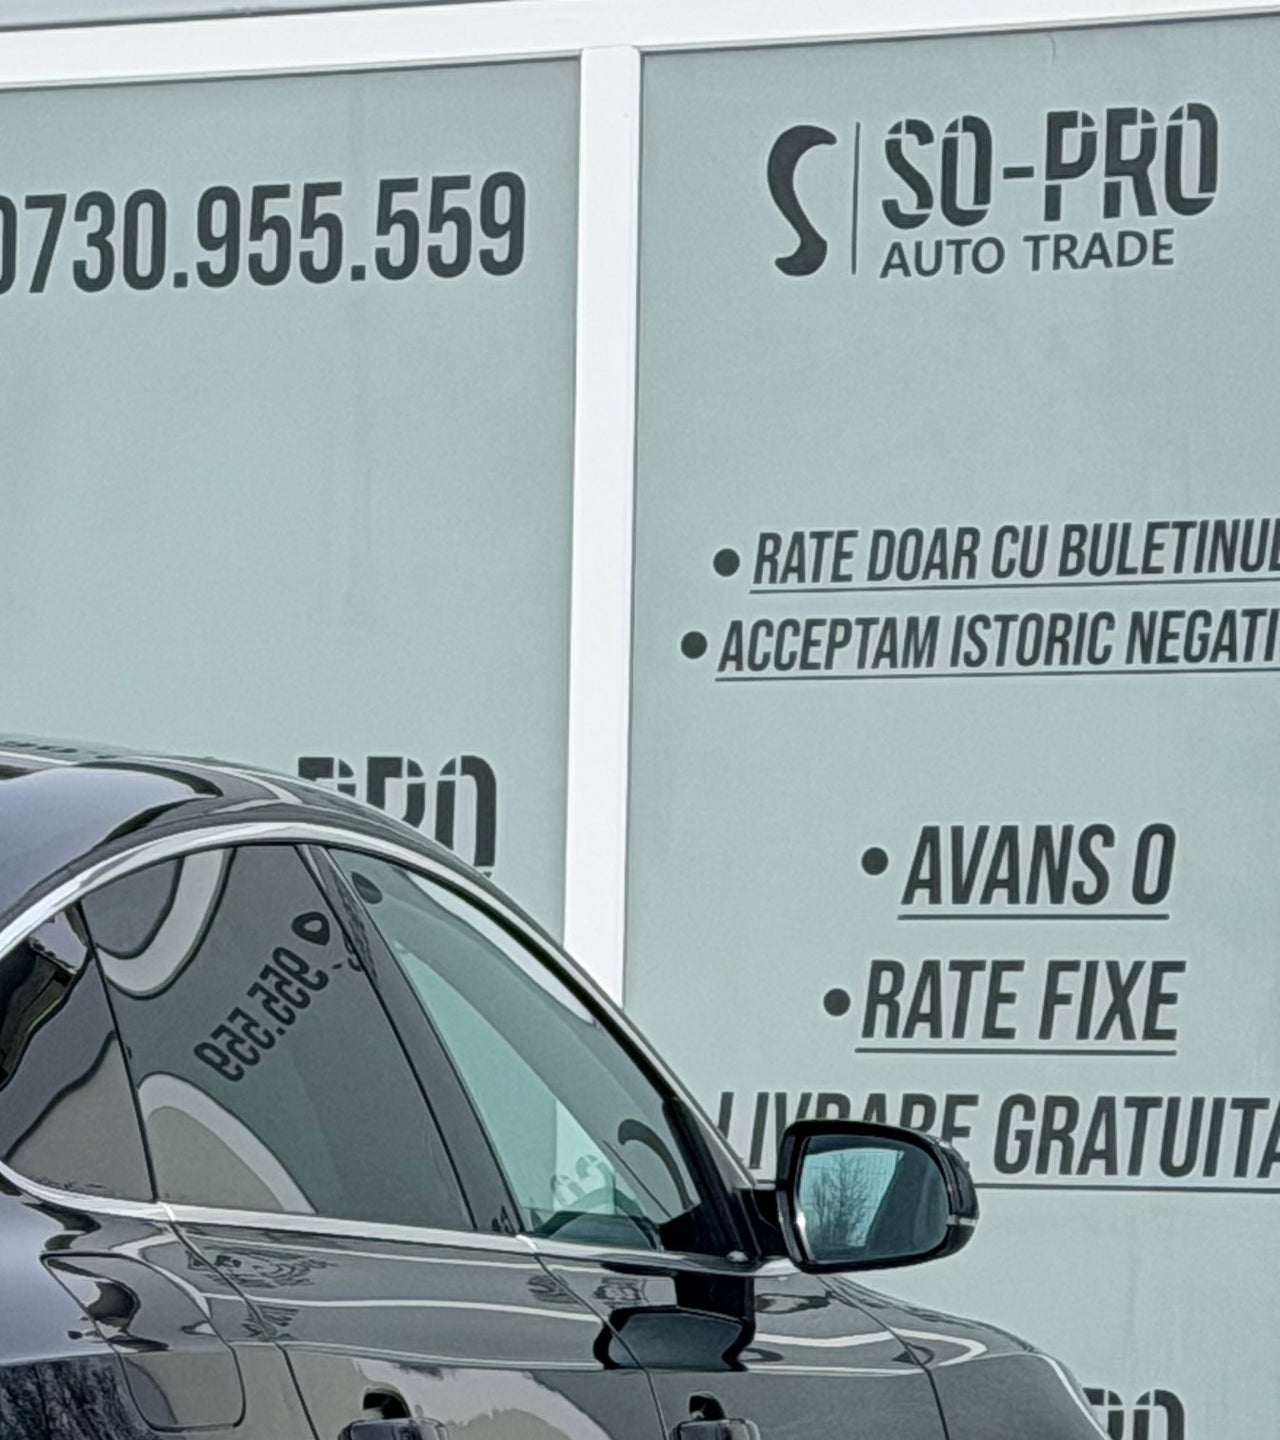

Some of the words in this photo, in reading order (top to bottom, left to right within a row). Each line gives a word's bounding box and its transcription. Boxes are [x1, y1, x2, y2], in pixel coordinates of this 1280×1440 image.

[882, 103, 1218, 229] SO-PRO
[880, 236, 1005, 278] AUTO
[1023, 229, 1174, 271] TRADE
[753, 529, 858, 585] RATE
[867, 527, 980, 582] DOAR
[991, 524, 1049, 578] CU
[717, 616, 940, 672] ACCEPTAM
[949, 611, 1115, 668] ISTORIC
[1125, 608, 1280, 665] NEGATI
[900, 823, 1115, 905] AVANS
[861, 959, 1025, 1039] RATE
[1038, 960, 1187, 1040] FIXE
